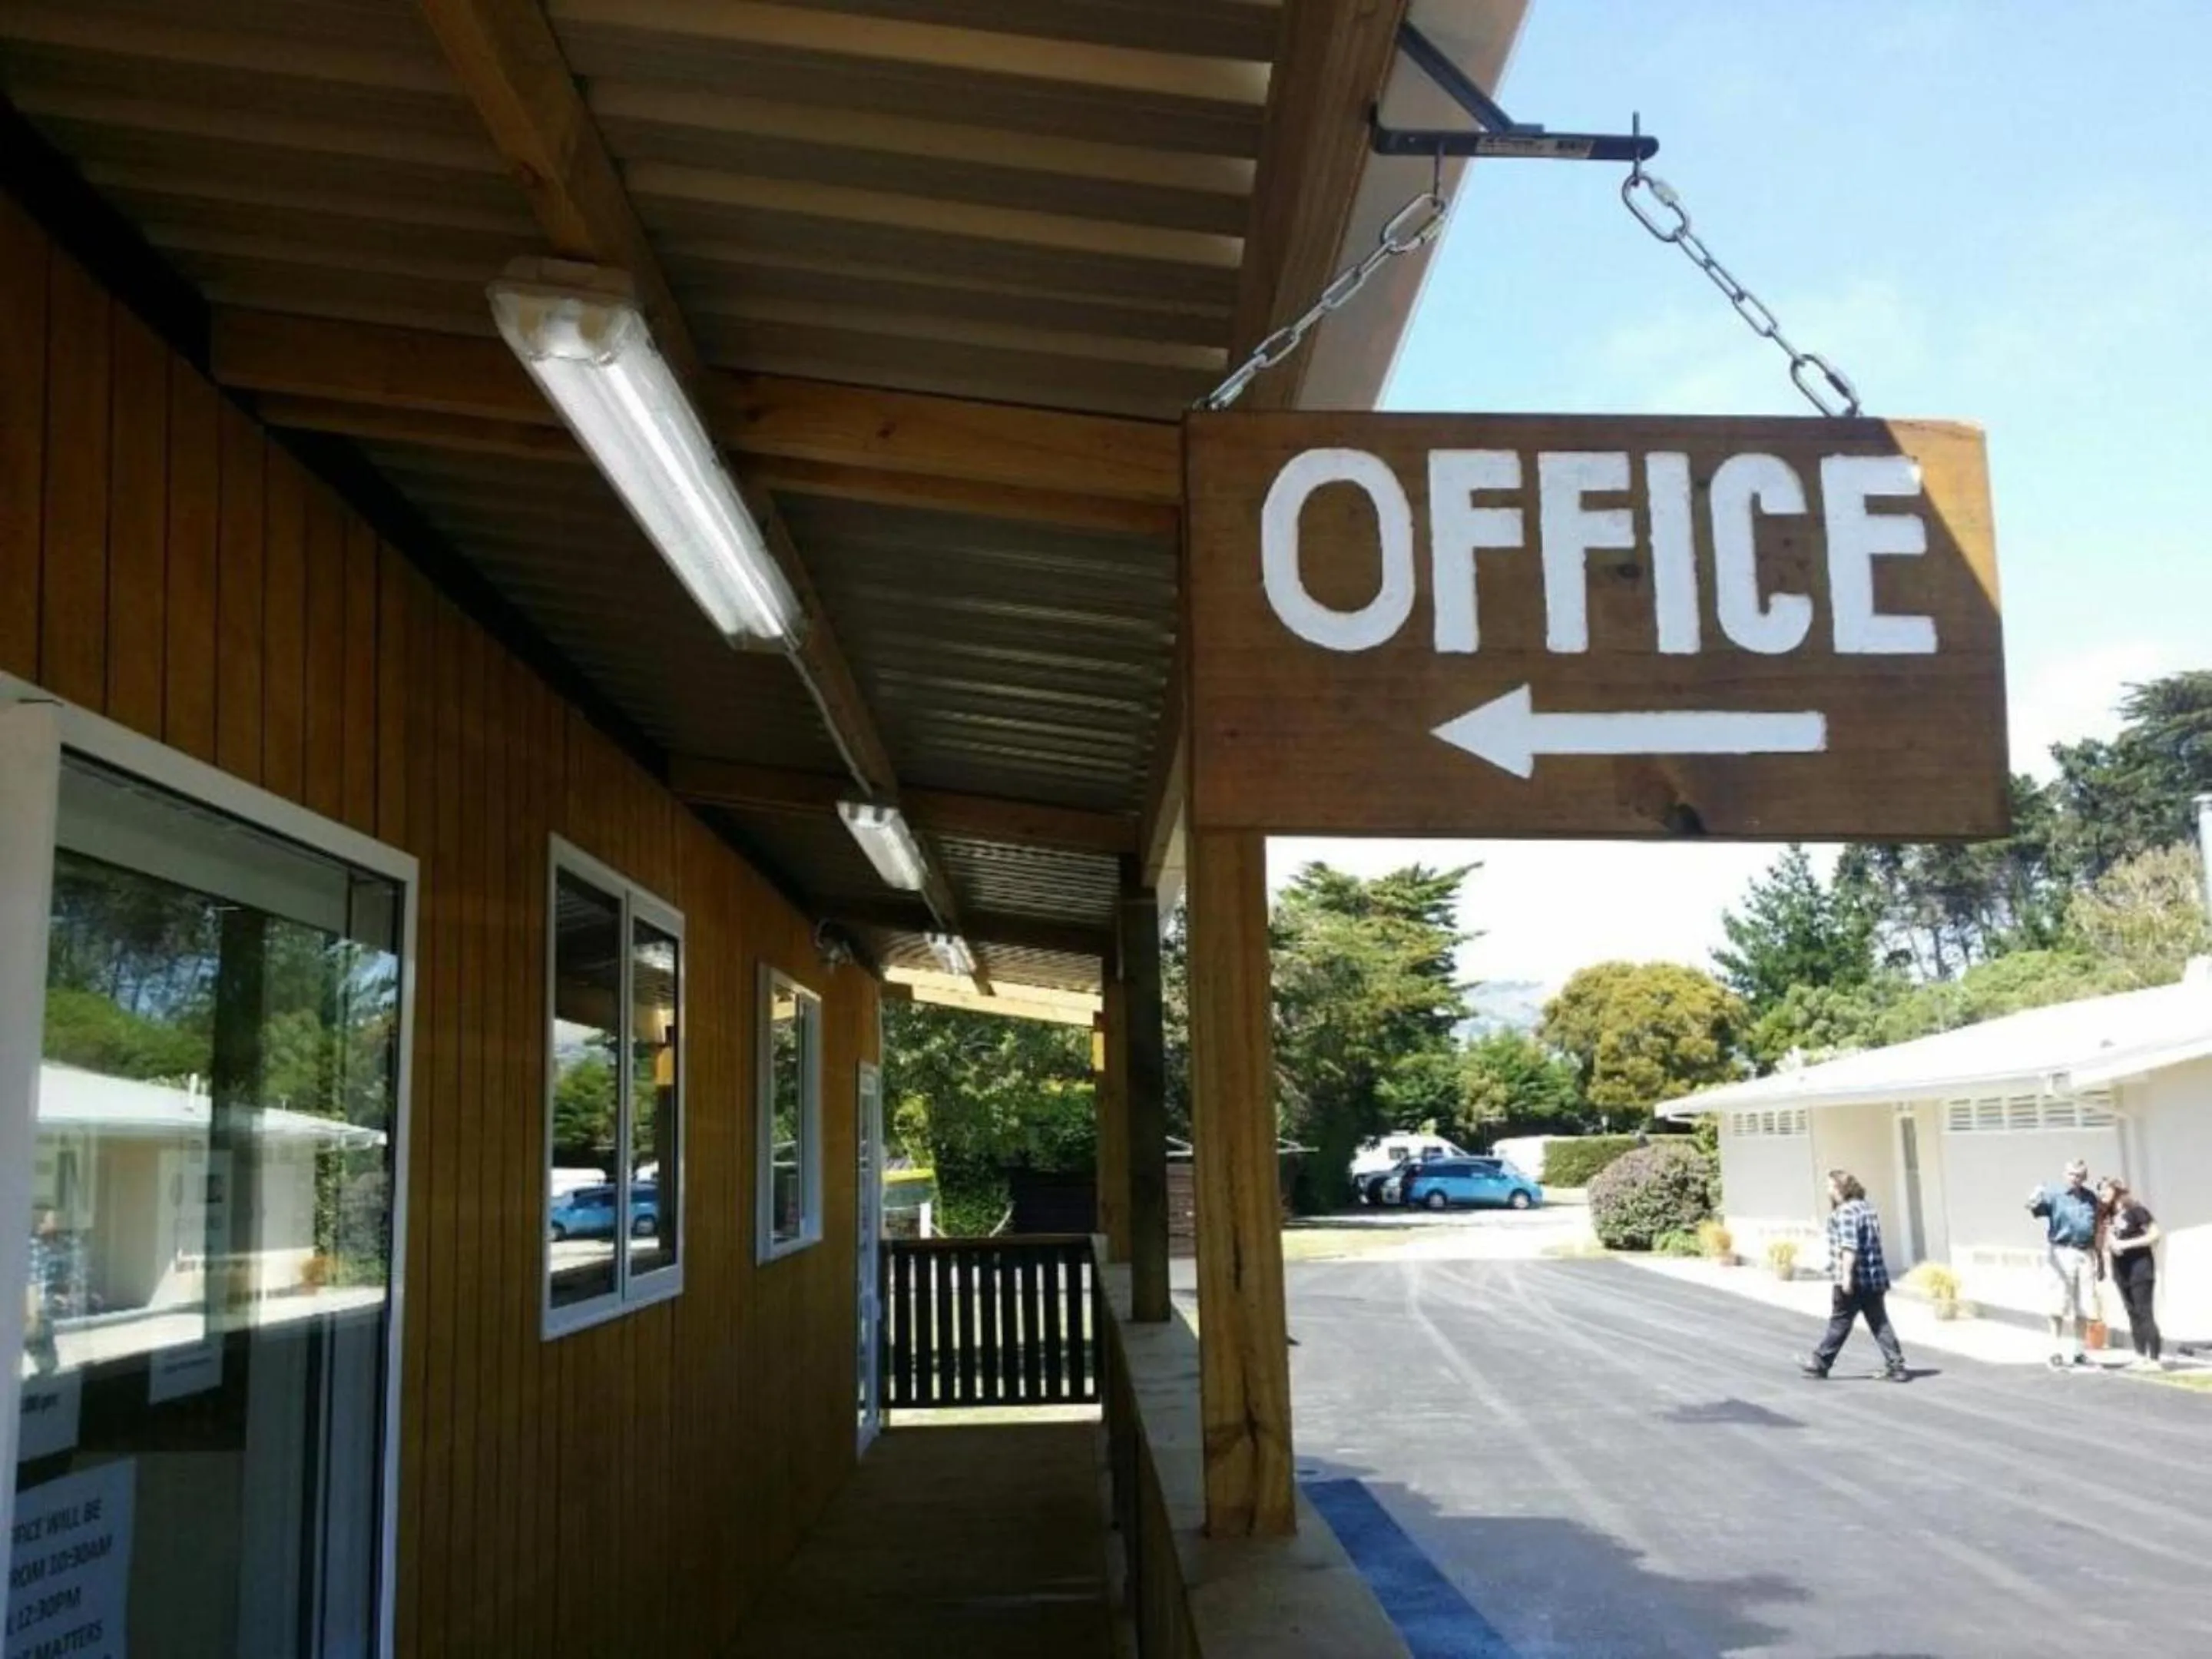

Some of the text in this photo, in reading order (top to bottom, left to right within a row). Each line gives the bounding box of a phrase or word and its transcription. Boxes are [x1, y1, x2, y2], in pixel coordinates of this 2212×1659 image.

[1260, 447, 1938, 654] OFFICE
[47, 1506, 80, 1535] WILL
[84, 1498, 101, 1522] BE
[48, 1534, 113, 1576] 10:30AM
[17, 1586, 81, 1630] 12:30PM
[35, 1618, 103, 1659] MATTERS
